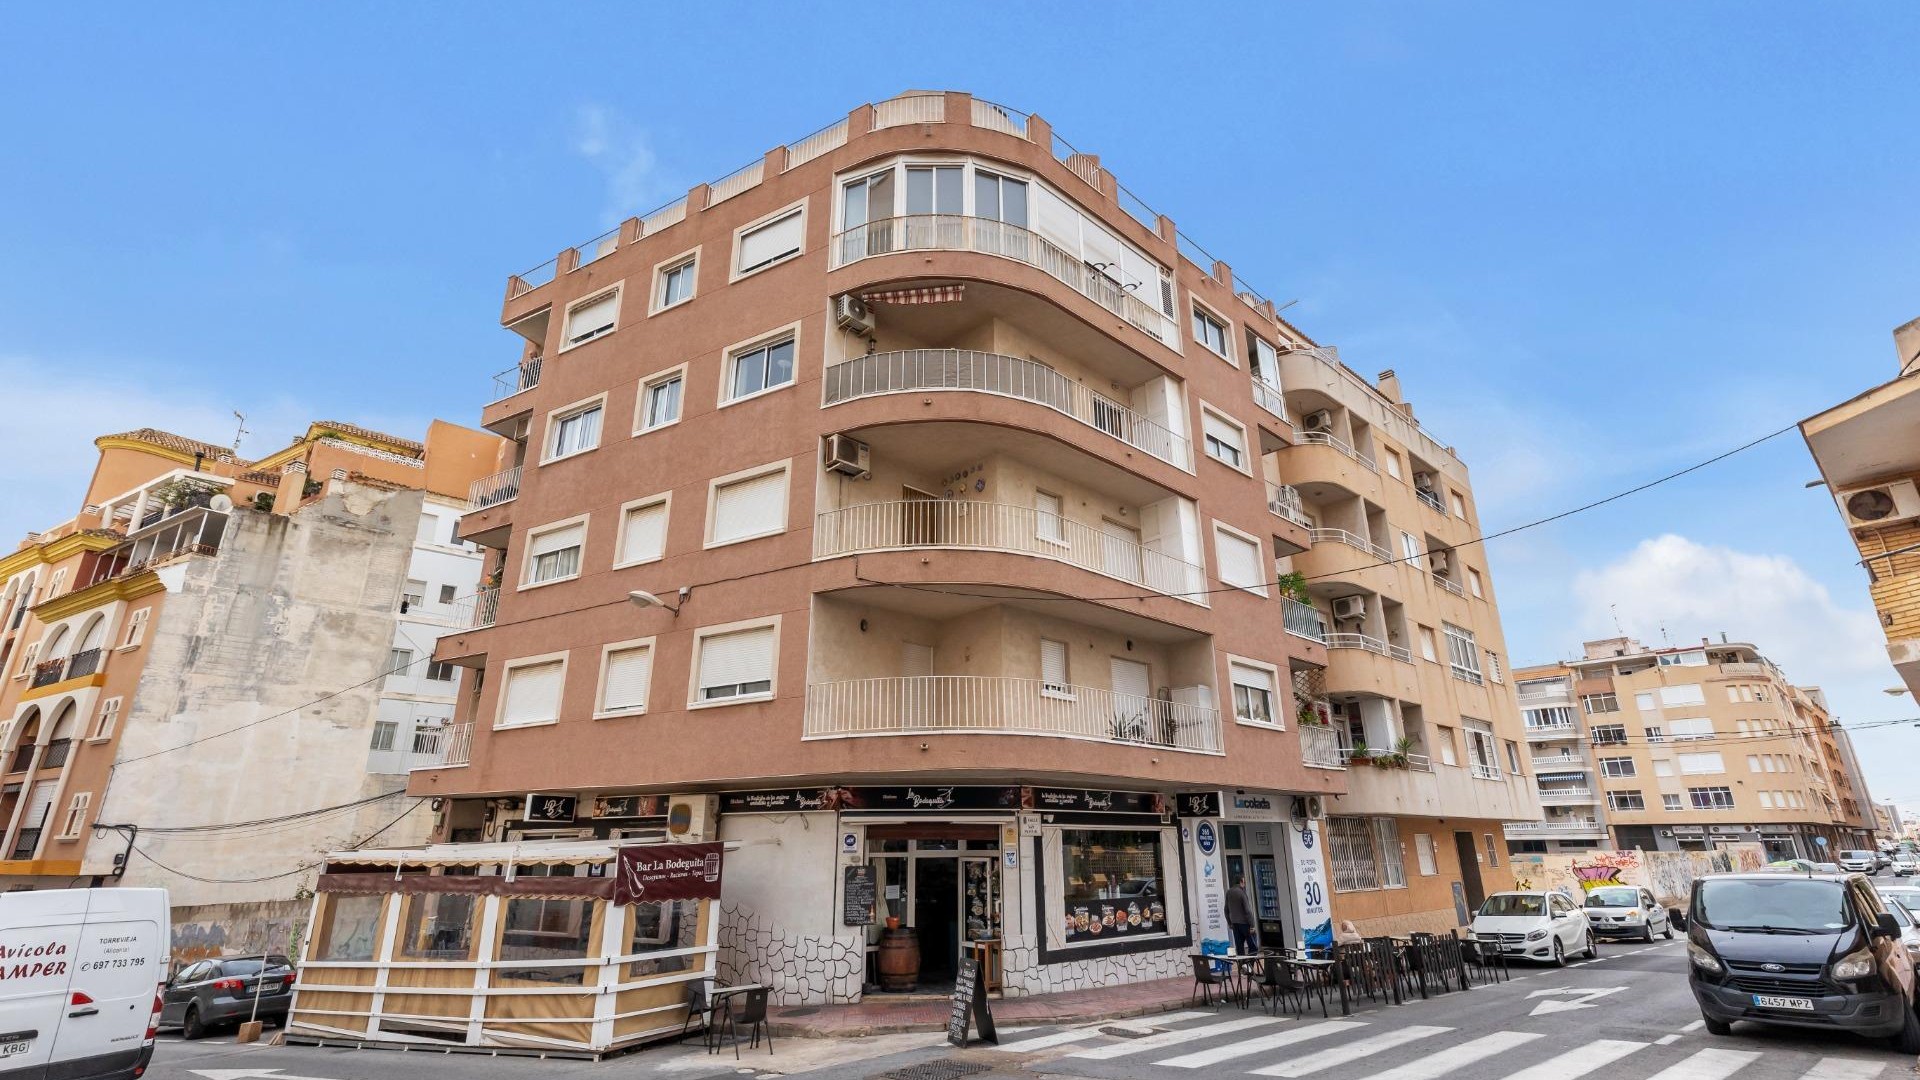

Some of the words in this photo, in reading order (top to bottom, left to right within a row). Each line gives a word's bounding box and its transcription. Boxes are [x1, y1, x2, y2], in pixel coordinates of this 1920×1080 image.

[636, 861, 652, 872] Bar
[653, 860, 664, 870] La
[665, 858, 704, 870] Bodeguita
[1304, 881, 1321, 906] 30
[99, 936, 137, 945] TORREVIEJA
[93, 960, 110, 970] 697
[112, 959, 128, 969] 733
[130, 957, 145, 967] 795
[1760, 997, 1786, 1007] 6457
[1789, 999, 1812, 1009] MPZ
[3, 1042, 26, 1055] KBG
